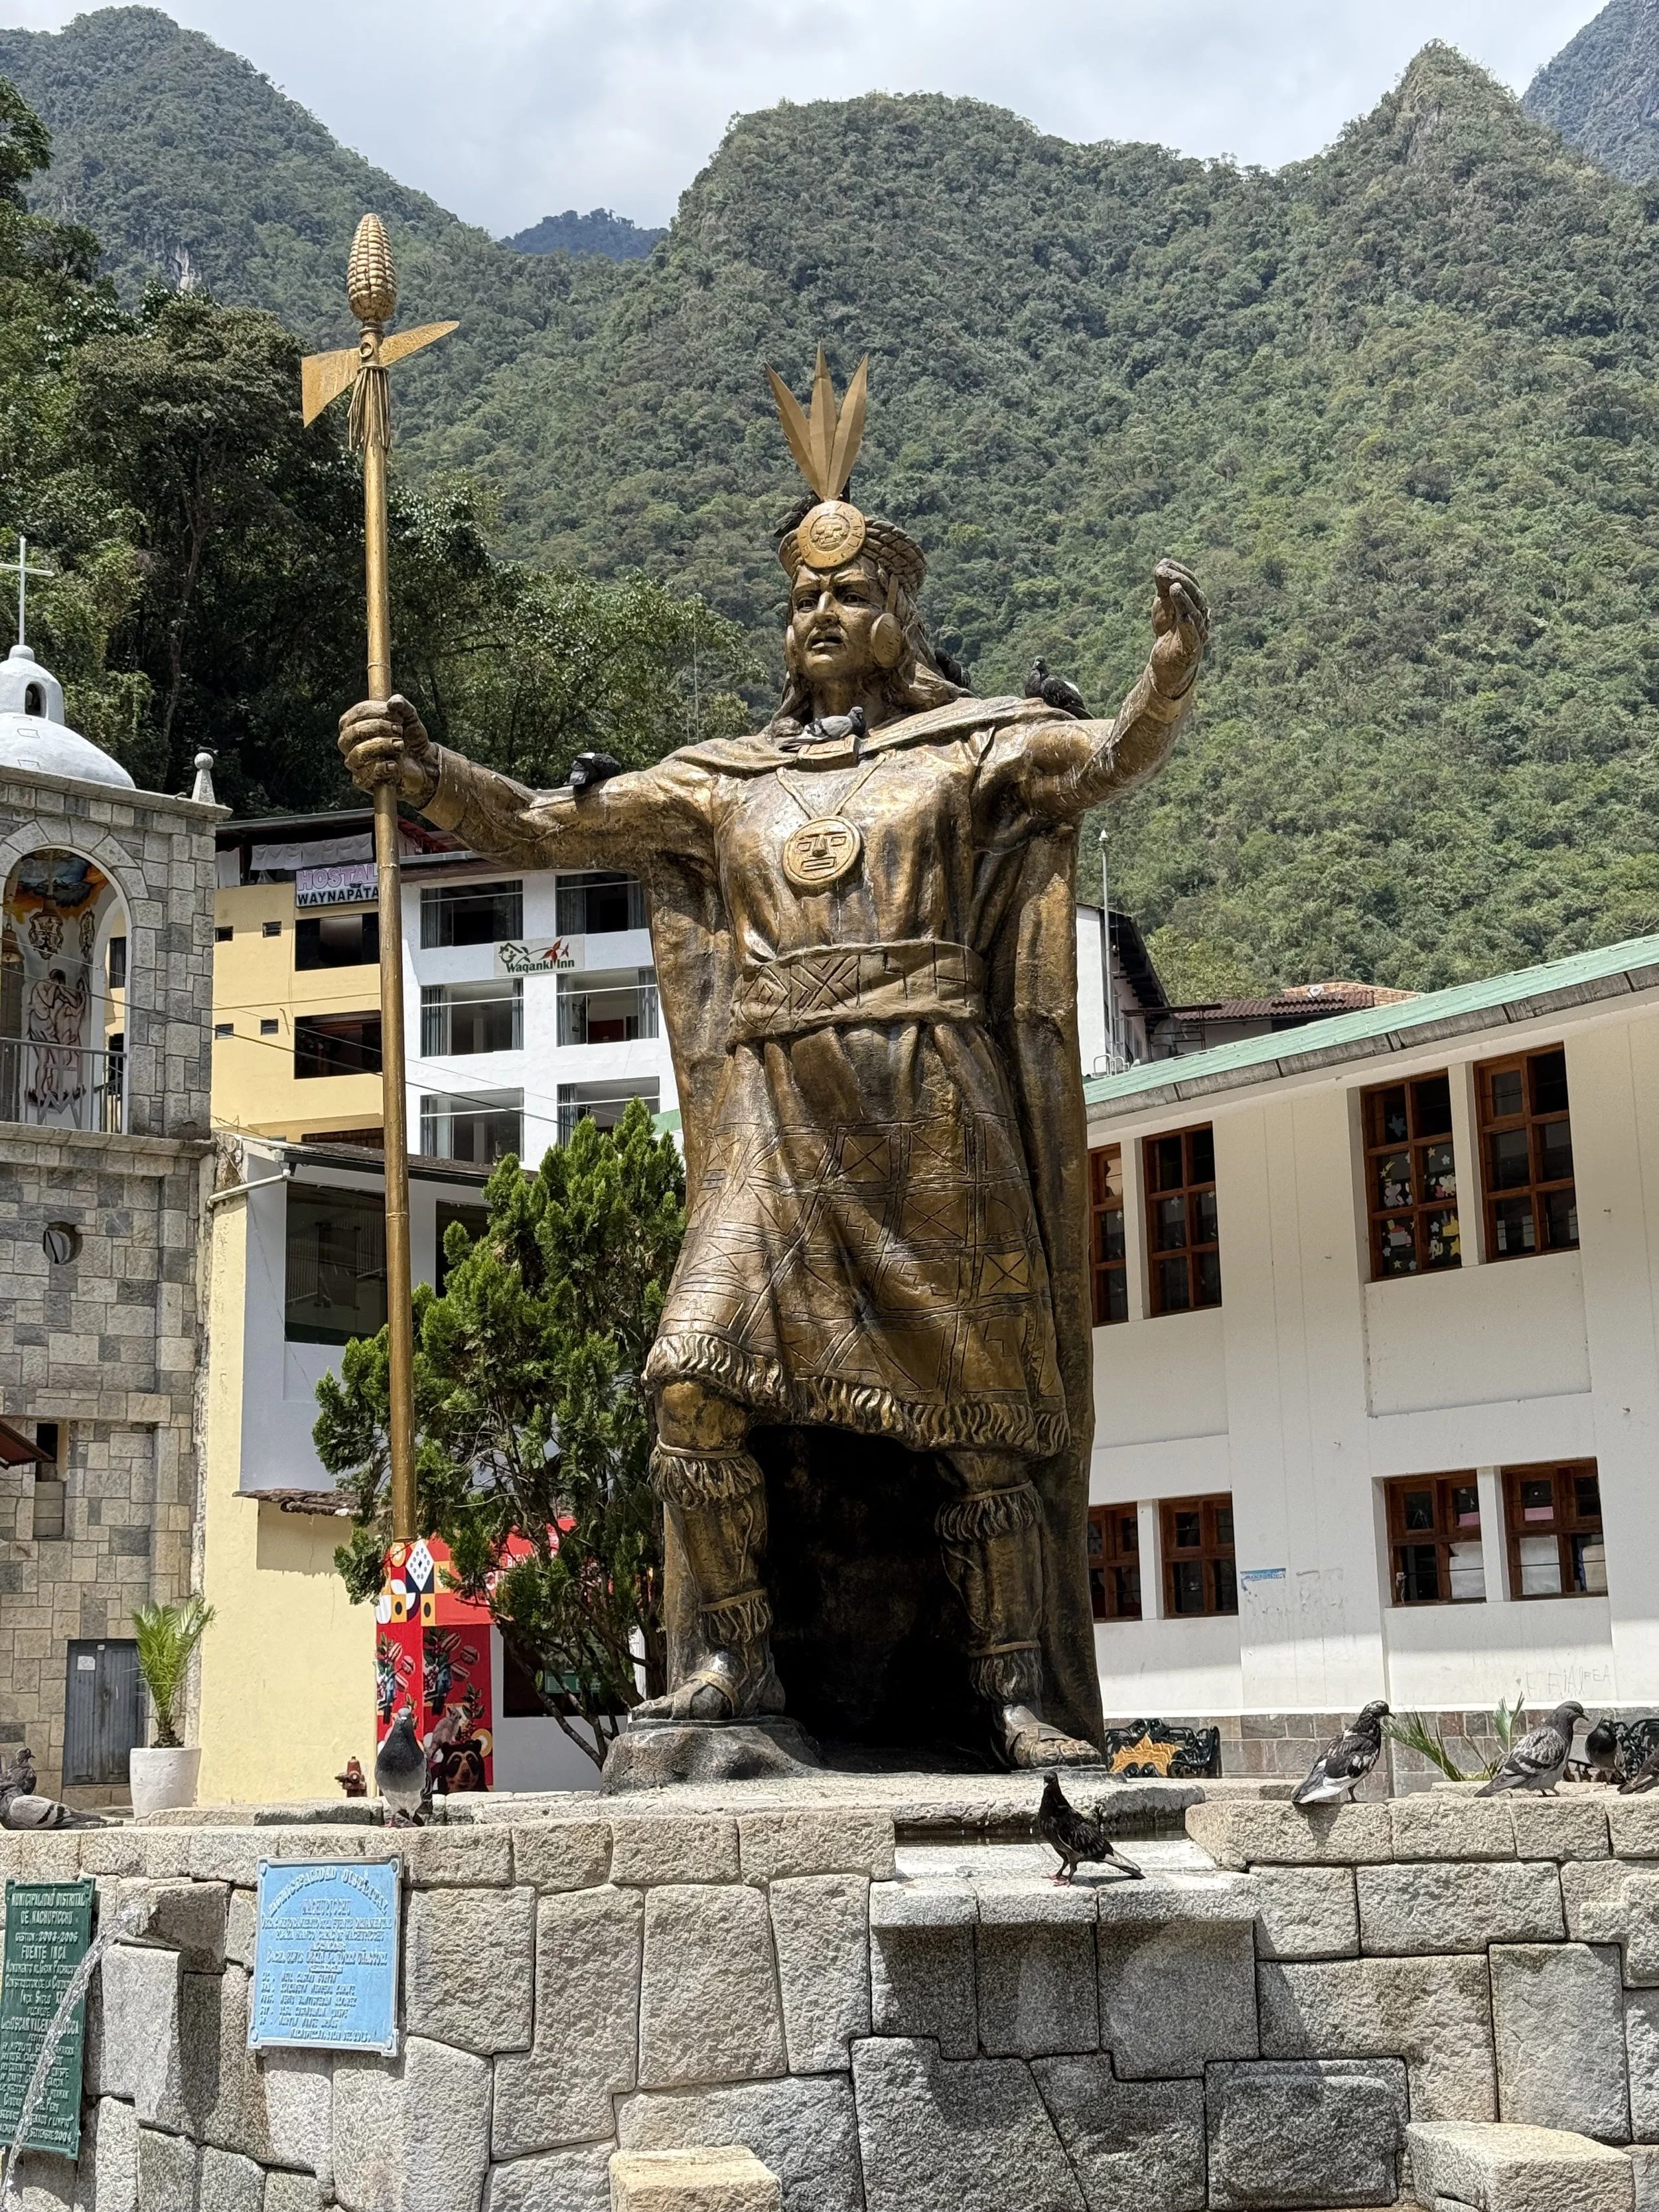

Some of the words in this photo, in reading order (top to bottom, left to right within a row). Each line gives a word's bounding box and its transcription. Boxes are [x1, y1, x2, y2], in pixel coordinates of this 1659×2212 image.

[297, 863, 378, 891] HOSTAL
[297, 887, 378, 905] WAYNAPATA
[557, 958, 575, 969] Inn
